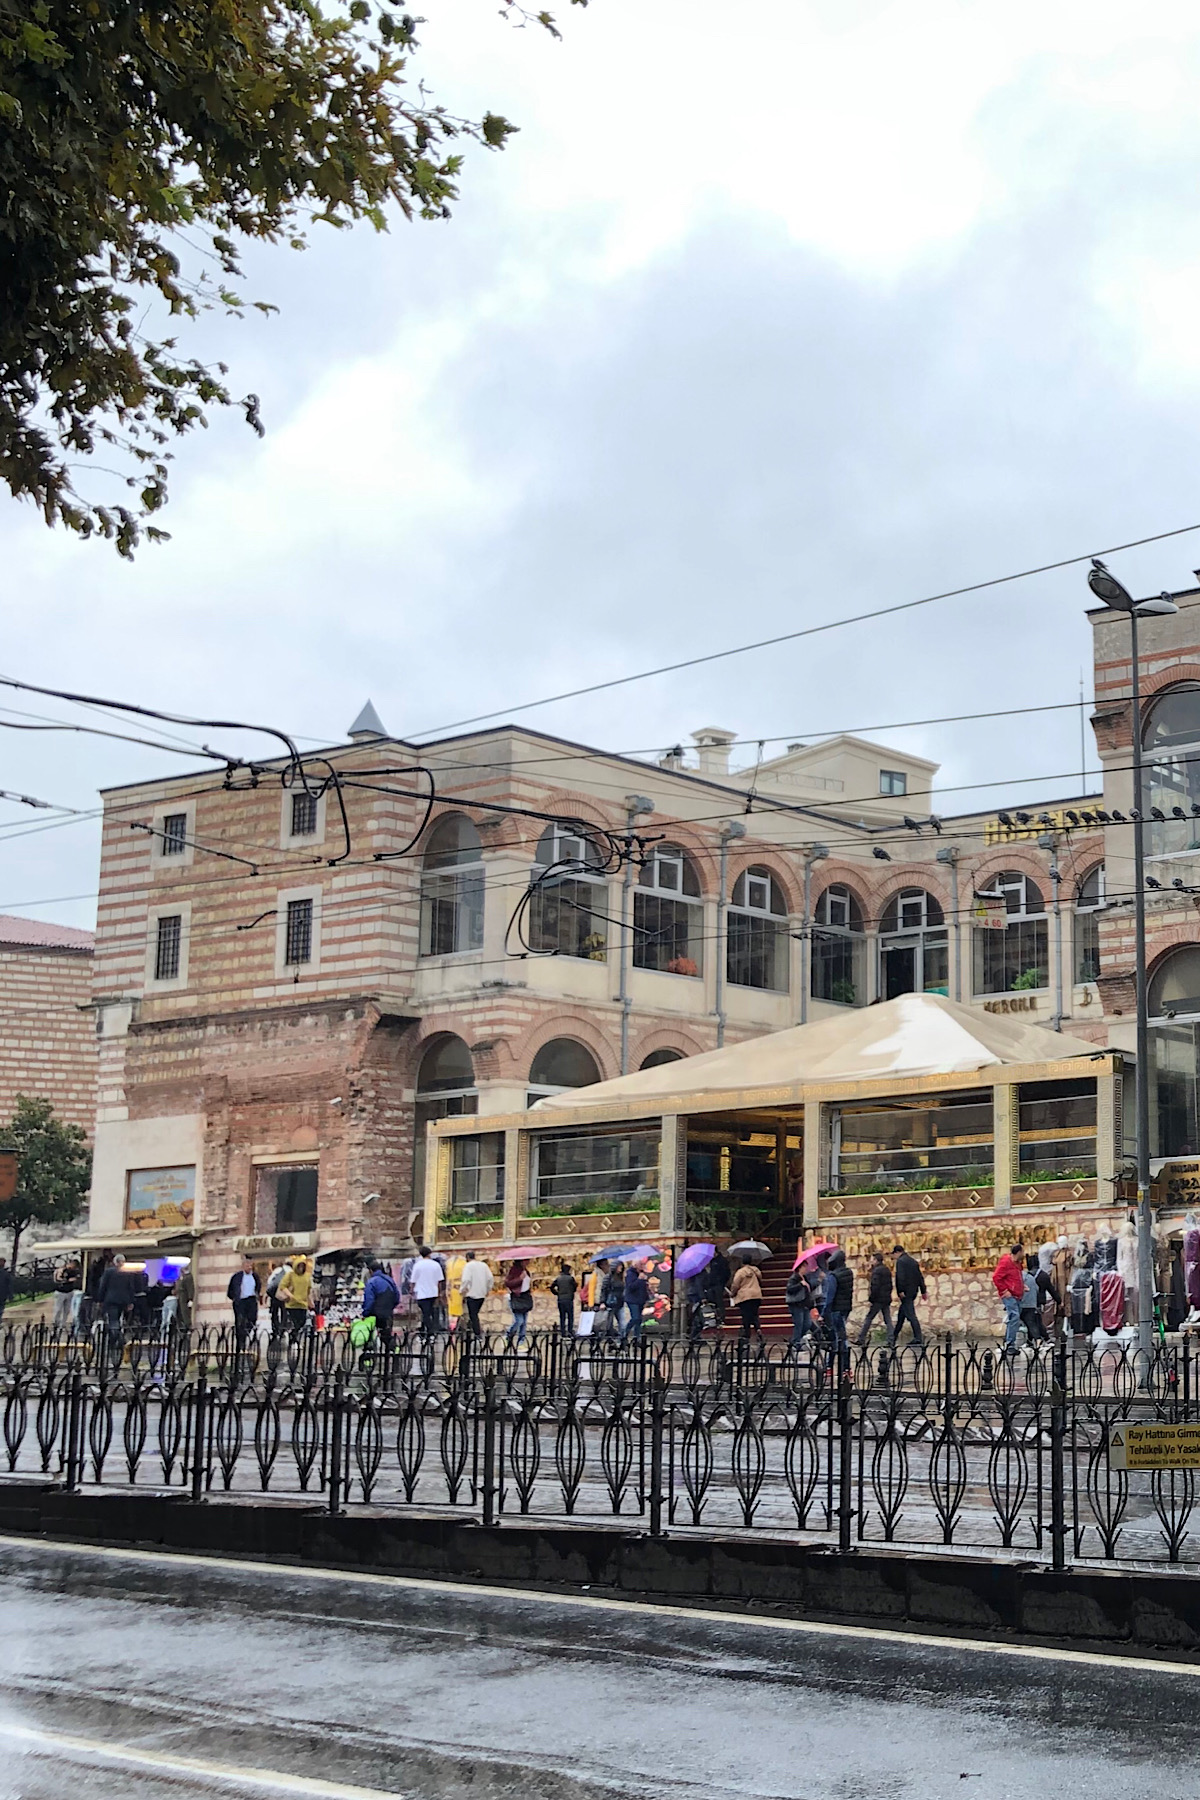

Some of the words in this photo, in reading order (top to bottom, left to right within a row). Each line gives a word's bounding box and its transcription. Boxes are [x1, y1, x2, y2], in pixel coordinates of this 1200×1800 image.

[1128, 1430, 1143, 1441] Ray
[1145, 1429, 1175, 1439] Hattına
[1129, 1445, 1162, 1455] Tehlikeli
[1164, 1445, 1175, 1455] Ve
